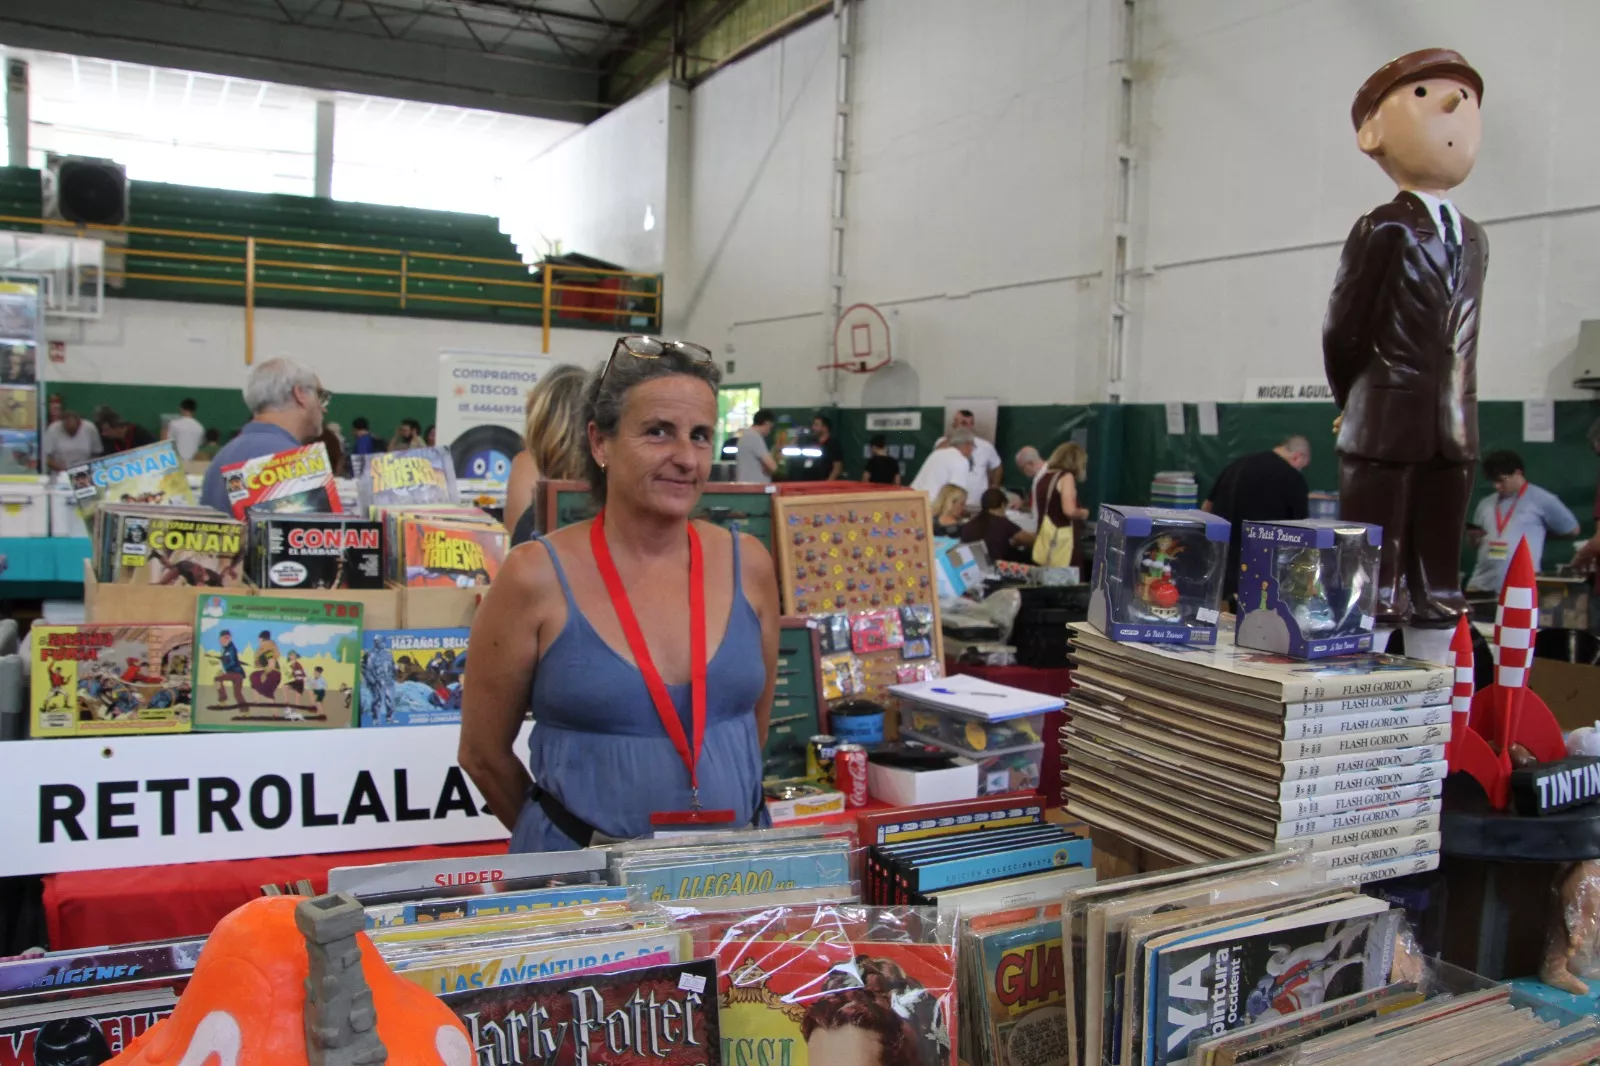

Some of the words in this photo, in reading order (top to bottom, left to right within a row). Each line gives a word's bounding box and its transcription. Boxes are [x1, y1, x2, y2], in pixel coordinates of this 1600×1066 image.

[453, 368, 538, 382] COMPRAMOS
[471, 384, 518, 396] DISCOS
[1258, 385, 1294, 398] MIGUEL
[92, 451, 177, 487] CONAN
[247, 456, 326, 490] CONAN
[148, 529, 240, 554] CONAN
[288, 528, 379, 549] CONAN
[1248, 527, 1256, 538] Le
[1258, 527, 1275, 540] Petit
[1277, 529, 1301, 542] Prince
[323, 603, 359, 618] TBO
[391, 636, 440, 650] HAZAÑAS
[41, 648, 98, 661] FURIA
[1342, 684, 1371, 695] FLASH
[1373, 679, 1412, 693] GORDON
[1341, 698, 1370, 711] FLASH
[1371, 694, 1410, 708] GORDON
[1340, 719, 1368, 732] FLASH
[1370, 715, 1409, 729] GORDON
[1339, 738, 1368, 751] FLASH
[1370, 733, 1409, 747] GORDON
[1336, 760, 1364, 773] FLASH
[1365, 755, 1403, 768] GORDON
[1335, 779, 1363, 791] FLASH
[1365, 773, 1403, 787] GORDON
[1536, 762, 1600, 809] TINTIN
[39, 767, 496, 843] RETROLALA
[1336, 796, 1363, 809] FLASH
[1363, 791, 1401, 804] GORDON
[1333, 815, 1360, 828] FLASH
[1362, 808, 1400, 822] GORDON
[1331, 833, 1359, 846] FLASH
[1360, 826, 1399, 840] GORDON
[1331, 855, 1359, 868] FLASH
[1360, 846, 1399, 860] GORDON
[1359, 867, 1399, 882] GORDON
[679, 869, 773, 900] LLEGADO
[440, 972, 483, 994] LAS
[1210, 947, 1230, 1036] pintura
[1228, 958, 1241, 1024] occident
[1167, 952, 1211, 1053] YA
[568, 986, 703, 1066] Potter
